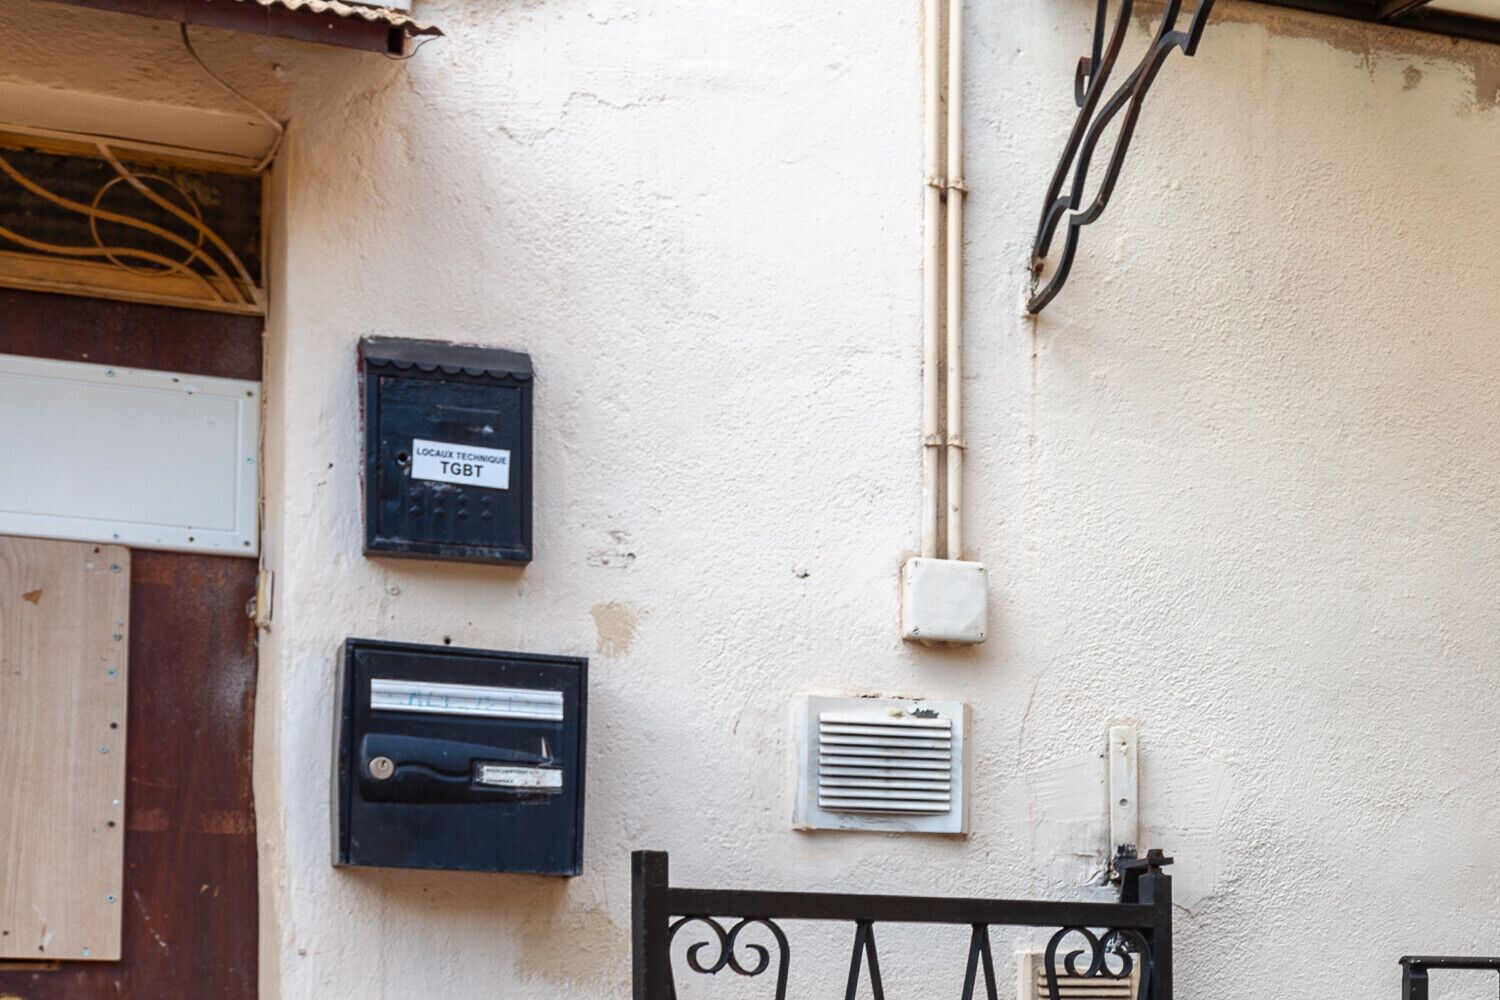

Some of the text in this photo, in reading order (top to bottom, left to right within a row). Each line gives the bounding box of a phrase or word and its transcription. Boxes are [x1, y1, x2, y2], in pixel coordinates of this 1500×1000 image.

[416, 447, 507, 465] LOCAUX TECHNIQUE
[440, 461, 484, 478] TGBT
